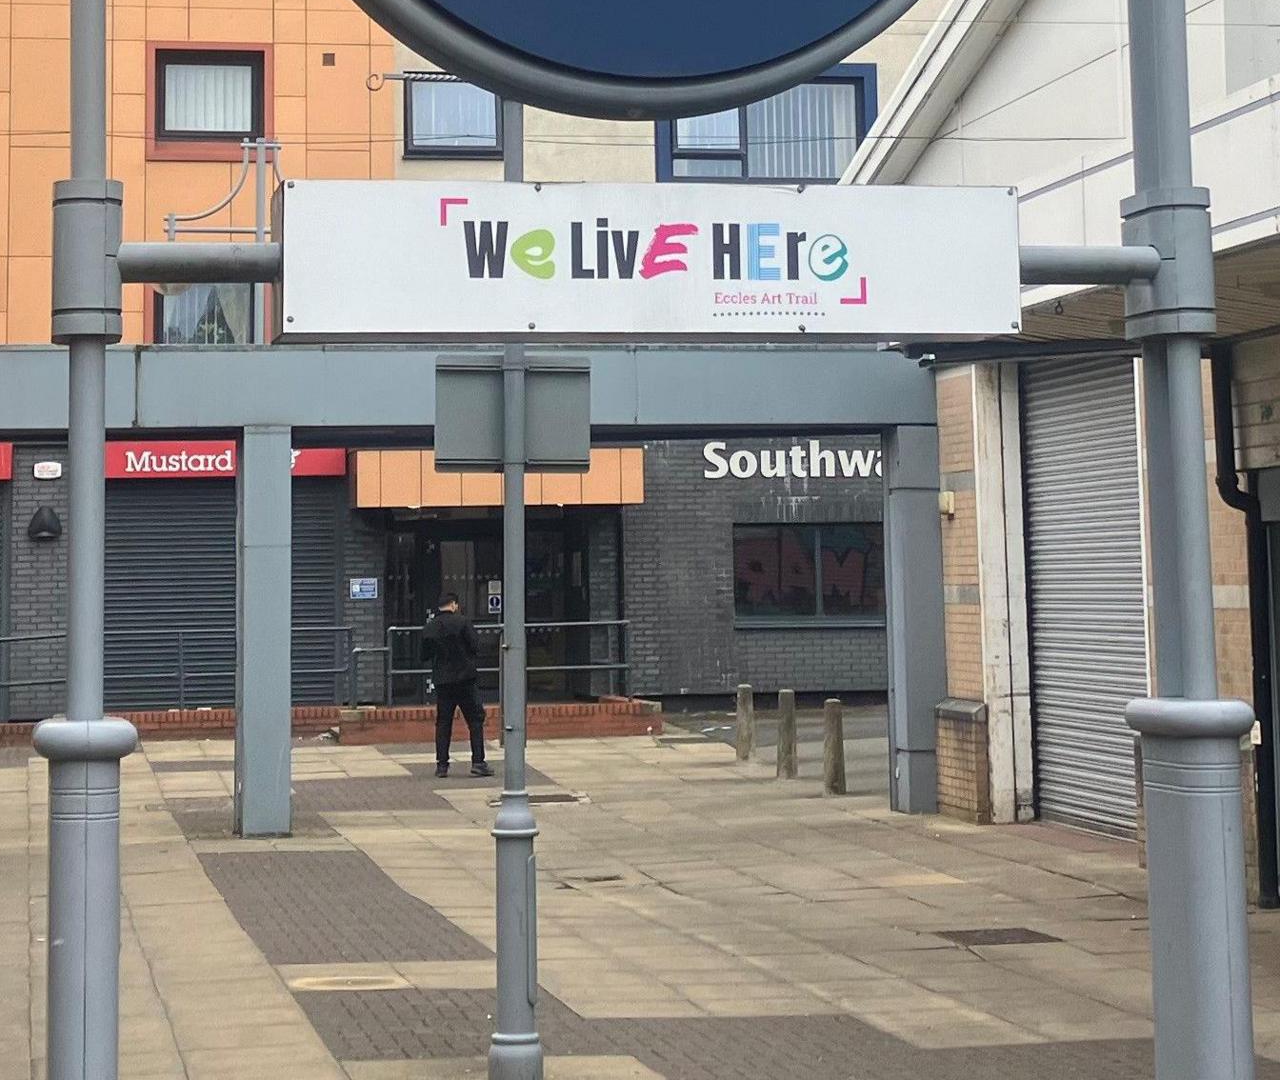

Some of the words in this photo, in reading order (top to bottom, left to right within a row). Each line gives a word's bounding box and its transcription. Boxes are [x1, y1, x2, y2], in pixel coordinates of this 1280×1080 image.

[714, 292, 757, 305] Eccles
[761, 292, 782, 305] Art
[786, 292, 818, 305] Trail
[125, 450, 233, 472] Mustard
